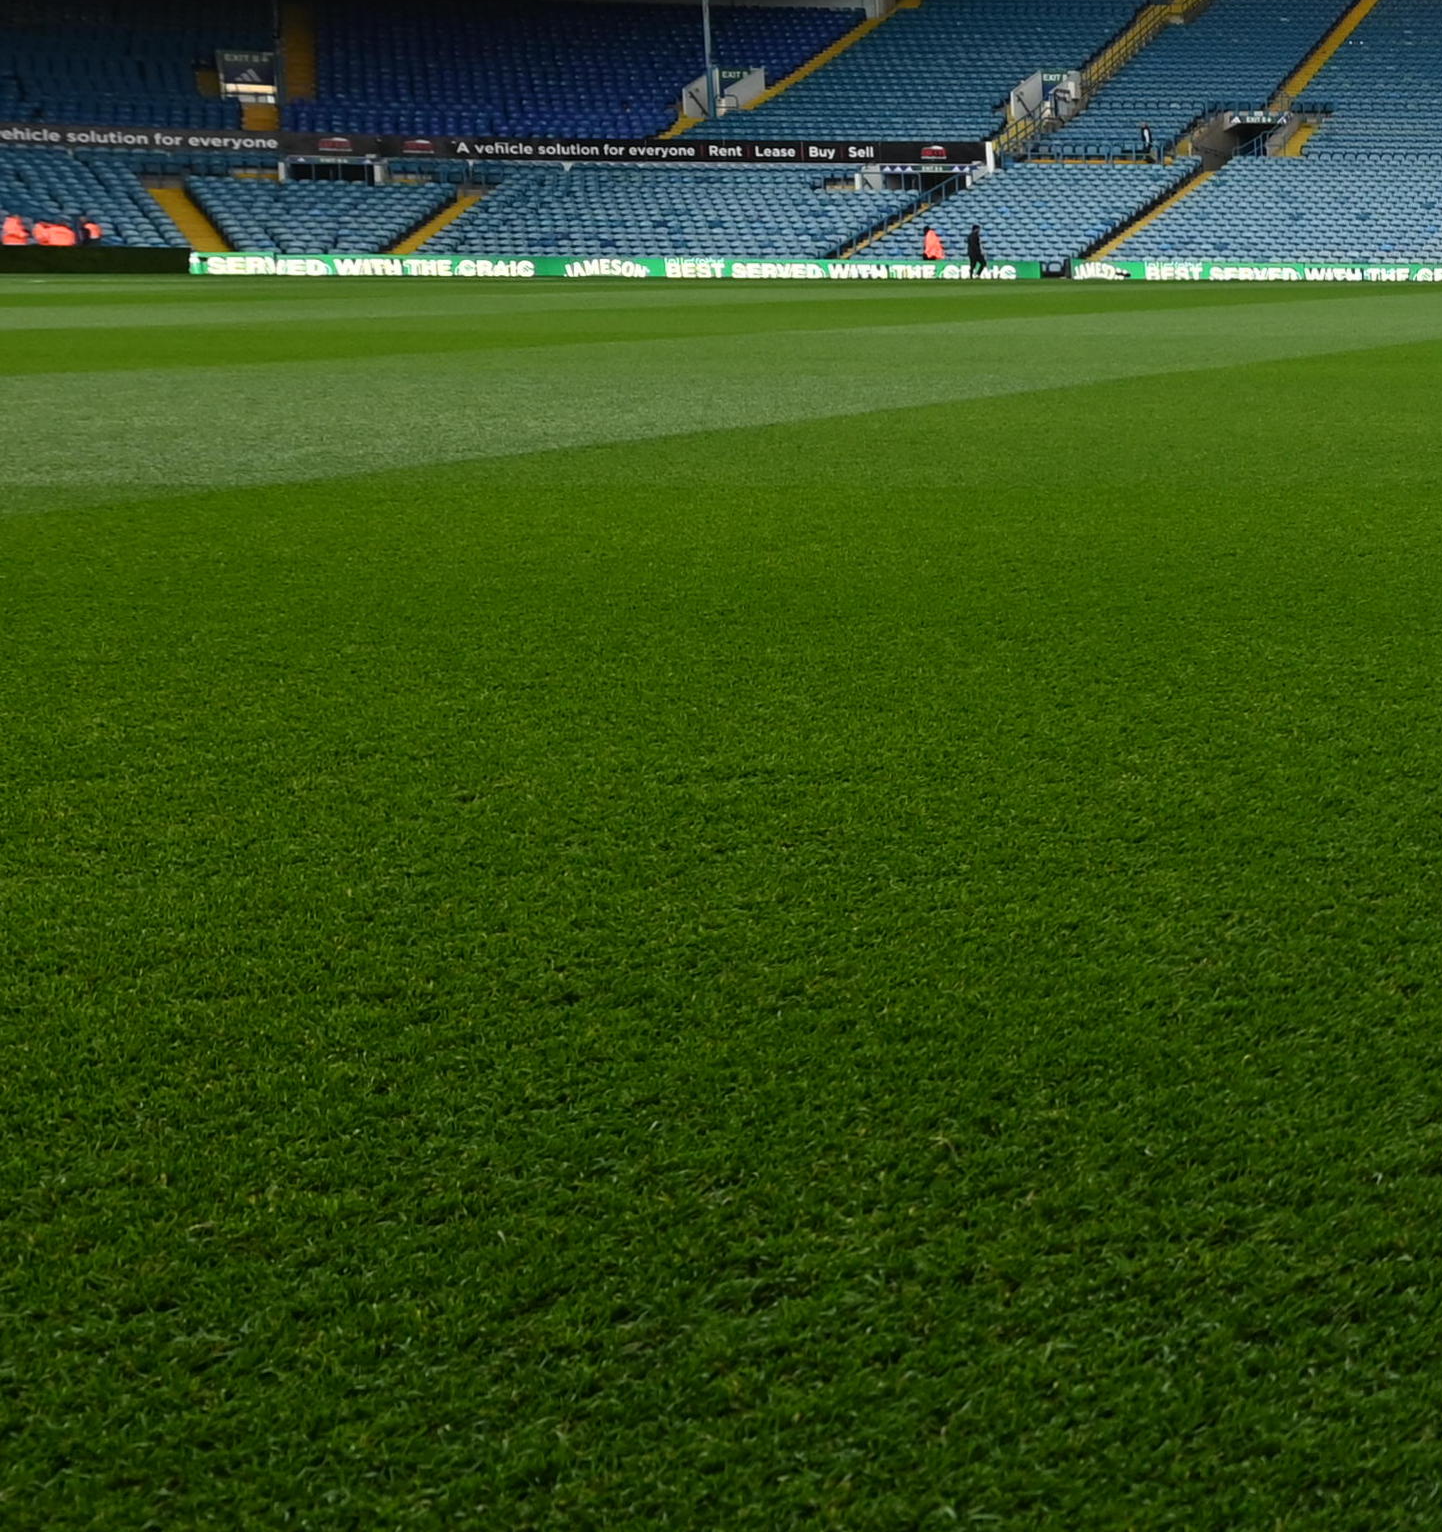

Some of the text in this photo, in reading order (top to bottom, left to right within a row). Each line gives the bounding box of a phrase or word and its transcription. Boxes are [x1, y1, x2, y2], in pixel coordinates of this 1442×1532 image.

[0, 128, 279, 150] ehicle solution for everyone
[456, 142, 695, 159] A vehicle solution for everyone
[708, 144, 743, 157] Rent
[755, 145, 796, 158] Lease
[808, 145, 836, 161] Buy
[848, 145, 875, 158] Sell
[564, 258, 650, 278] JAMESON
